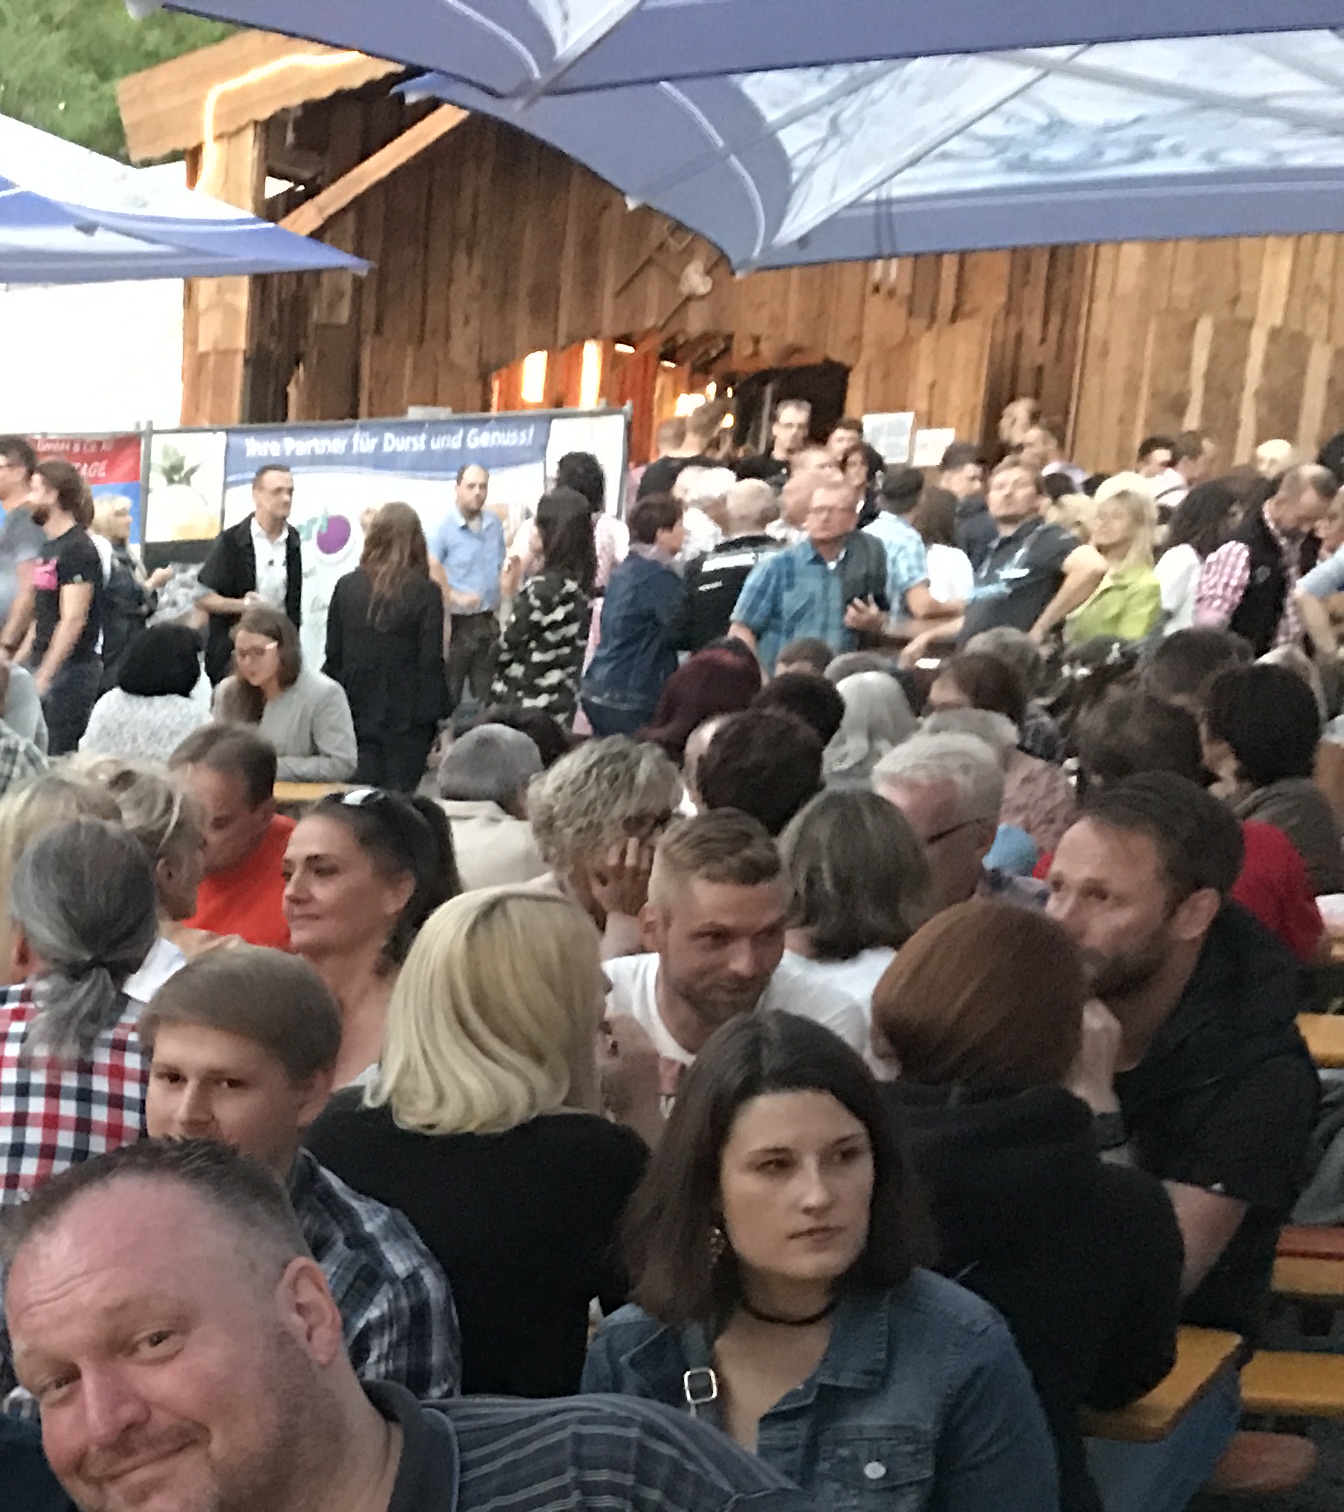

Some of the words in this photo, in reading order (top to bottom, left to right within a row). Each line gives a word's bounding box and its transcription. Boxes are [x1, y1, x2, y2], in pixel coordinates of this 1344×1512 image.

[283, 437, 348, 457] Partner
[352, 431, 379, 454] für
[383, 432, 427, 453] Durst
[430, 429, 464, 451] und
